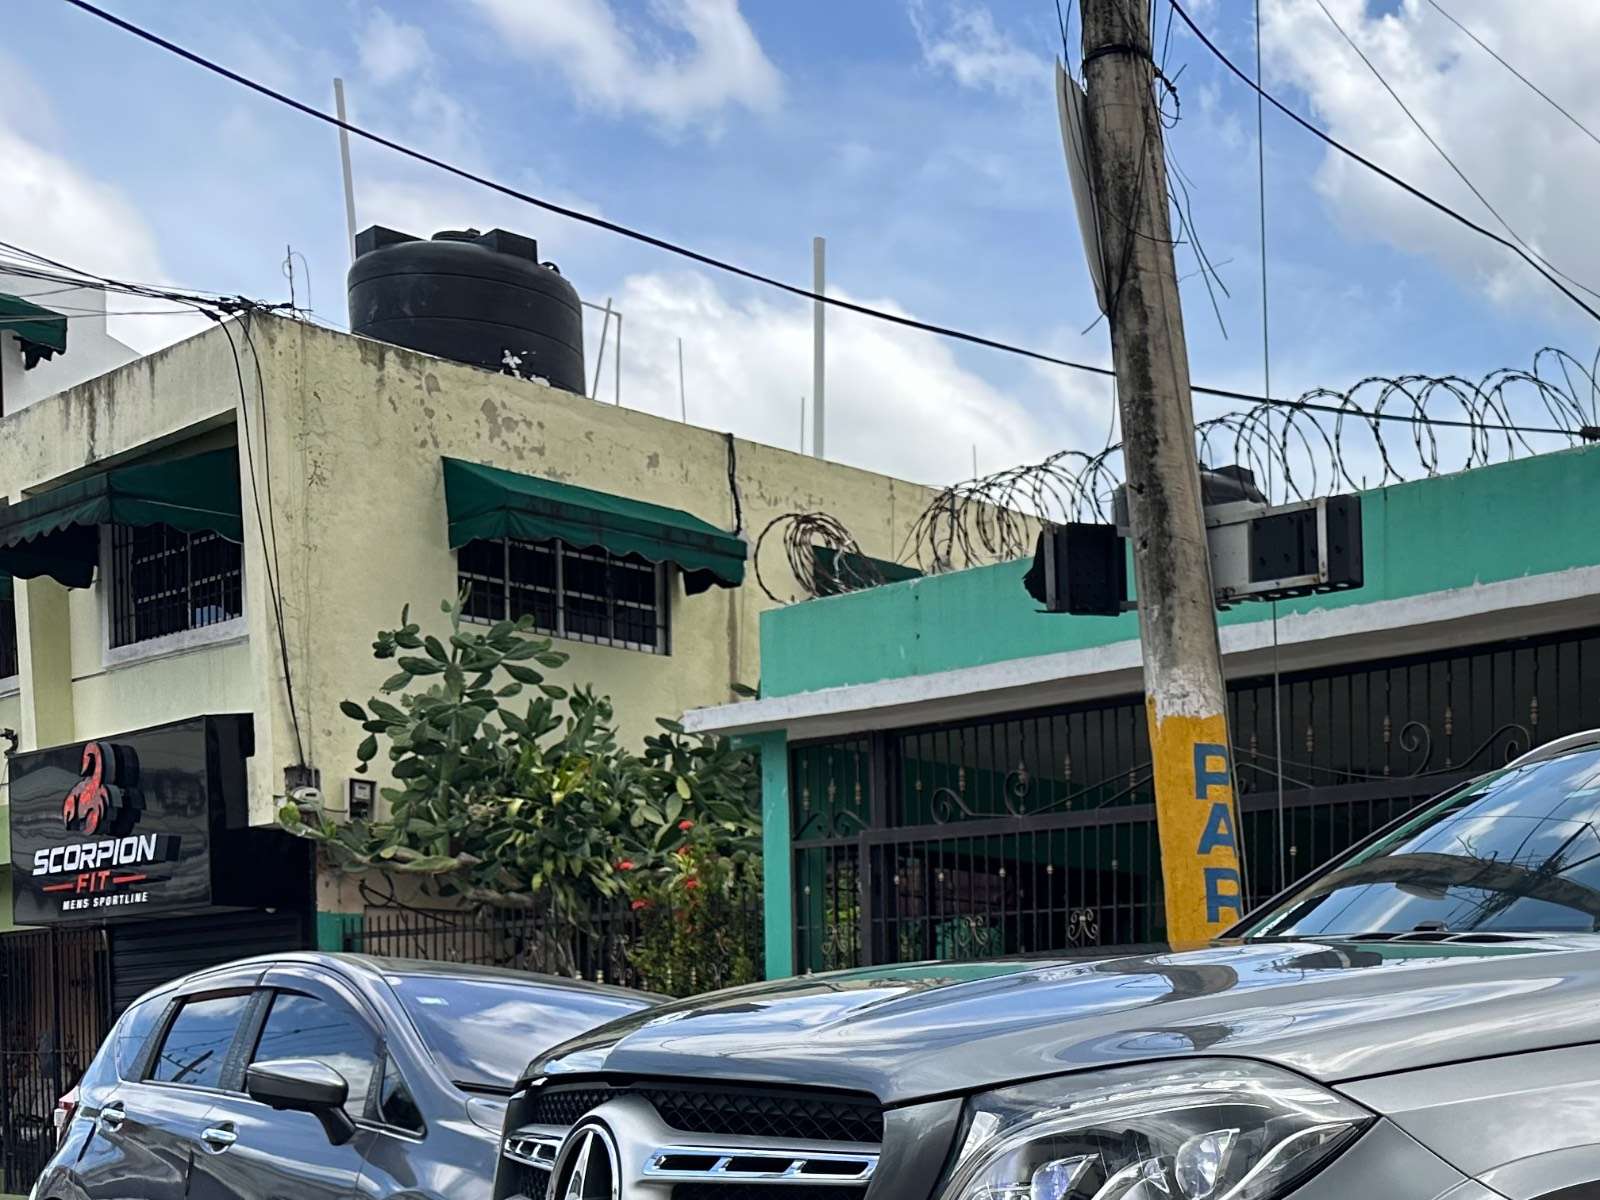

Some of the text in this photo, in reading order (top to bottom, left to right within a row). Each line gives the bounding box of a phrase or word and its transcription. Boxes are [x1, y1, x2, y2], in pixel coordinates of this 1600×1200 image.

[32, 833, 158, 876] SCORPION
[75, 870, 112, 893] FIT
[62, 891, 149, 911] MENS SPORTLINE
